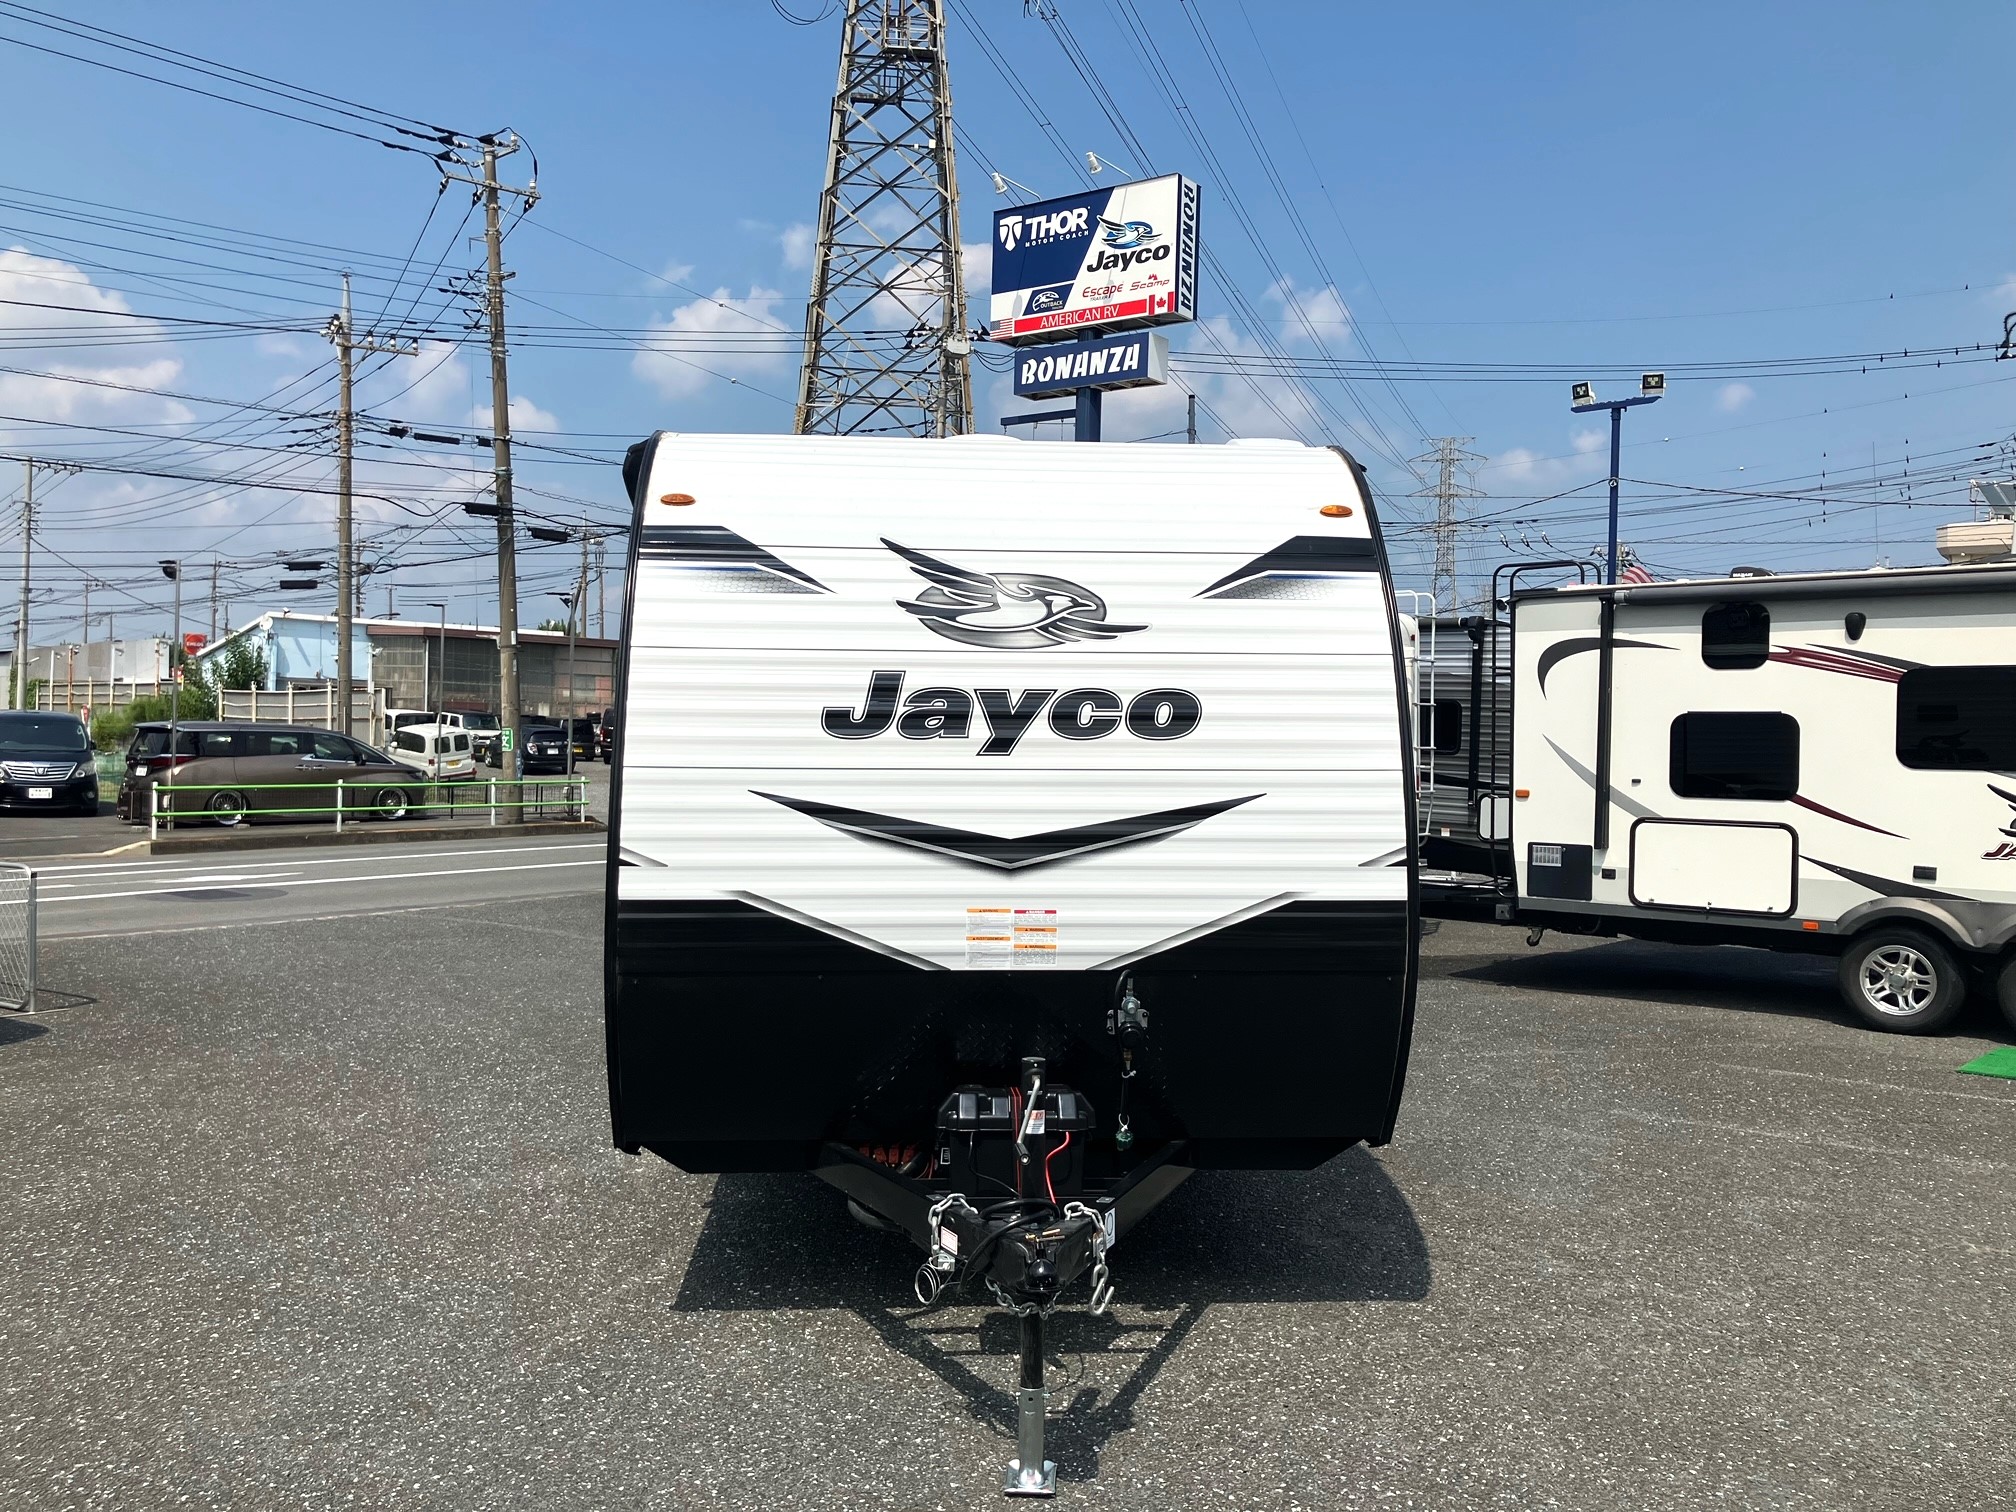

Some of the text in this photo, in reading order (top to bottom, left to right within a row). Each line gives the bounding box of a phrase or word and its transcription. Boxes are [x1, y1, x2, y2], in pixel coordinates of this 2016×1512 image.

[1025, 207, 1089, 240] THOR
[1025, 230, 1089, 248] MOTOR COACH
[1086, 244, 1171, 273] Jayco
[1181, 183, 1195, 312] BONANZA
[1039, 304, 1120, 329] AMERICAN RV
[1040, 300, 1063, 309] OUTBACK
[1021, 343, 1140, 385] BONANZA
[821, 670, 1202, 756] Jayco
